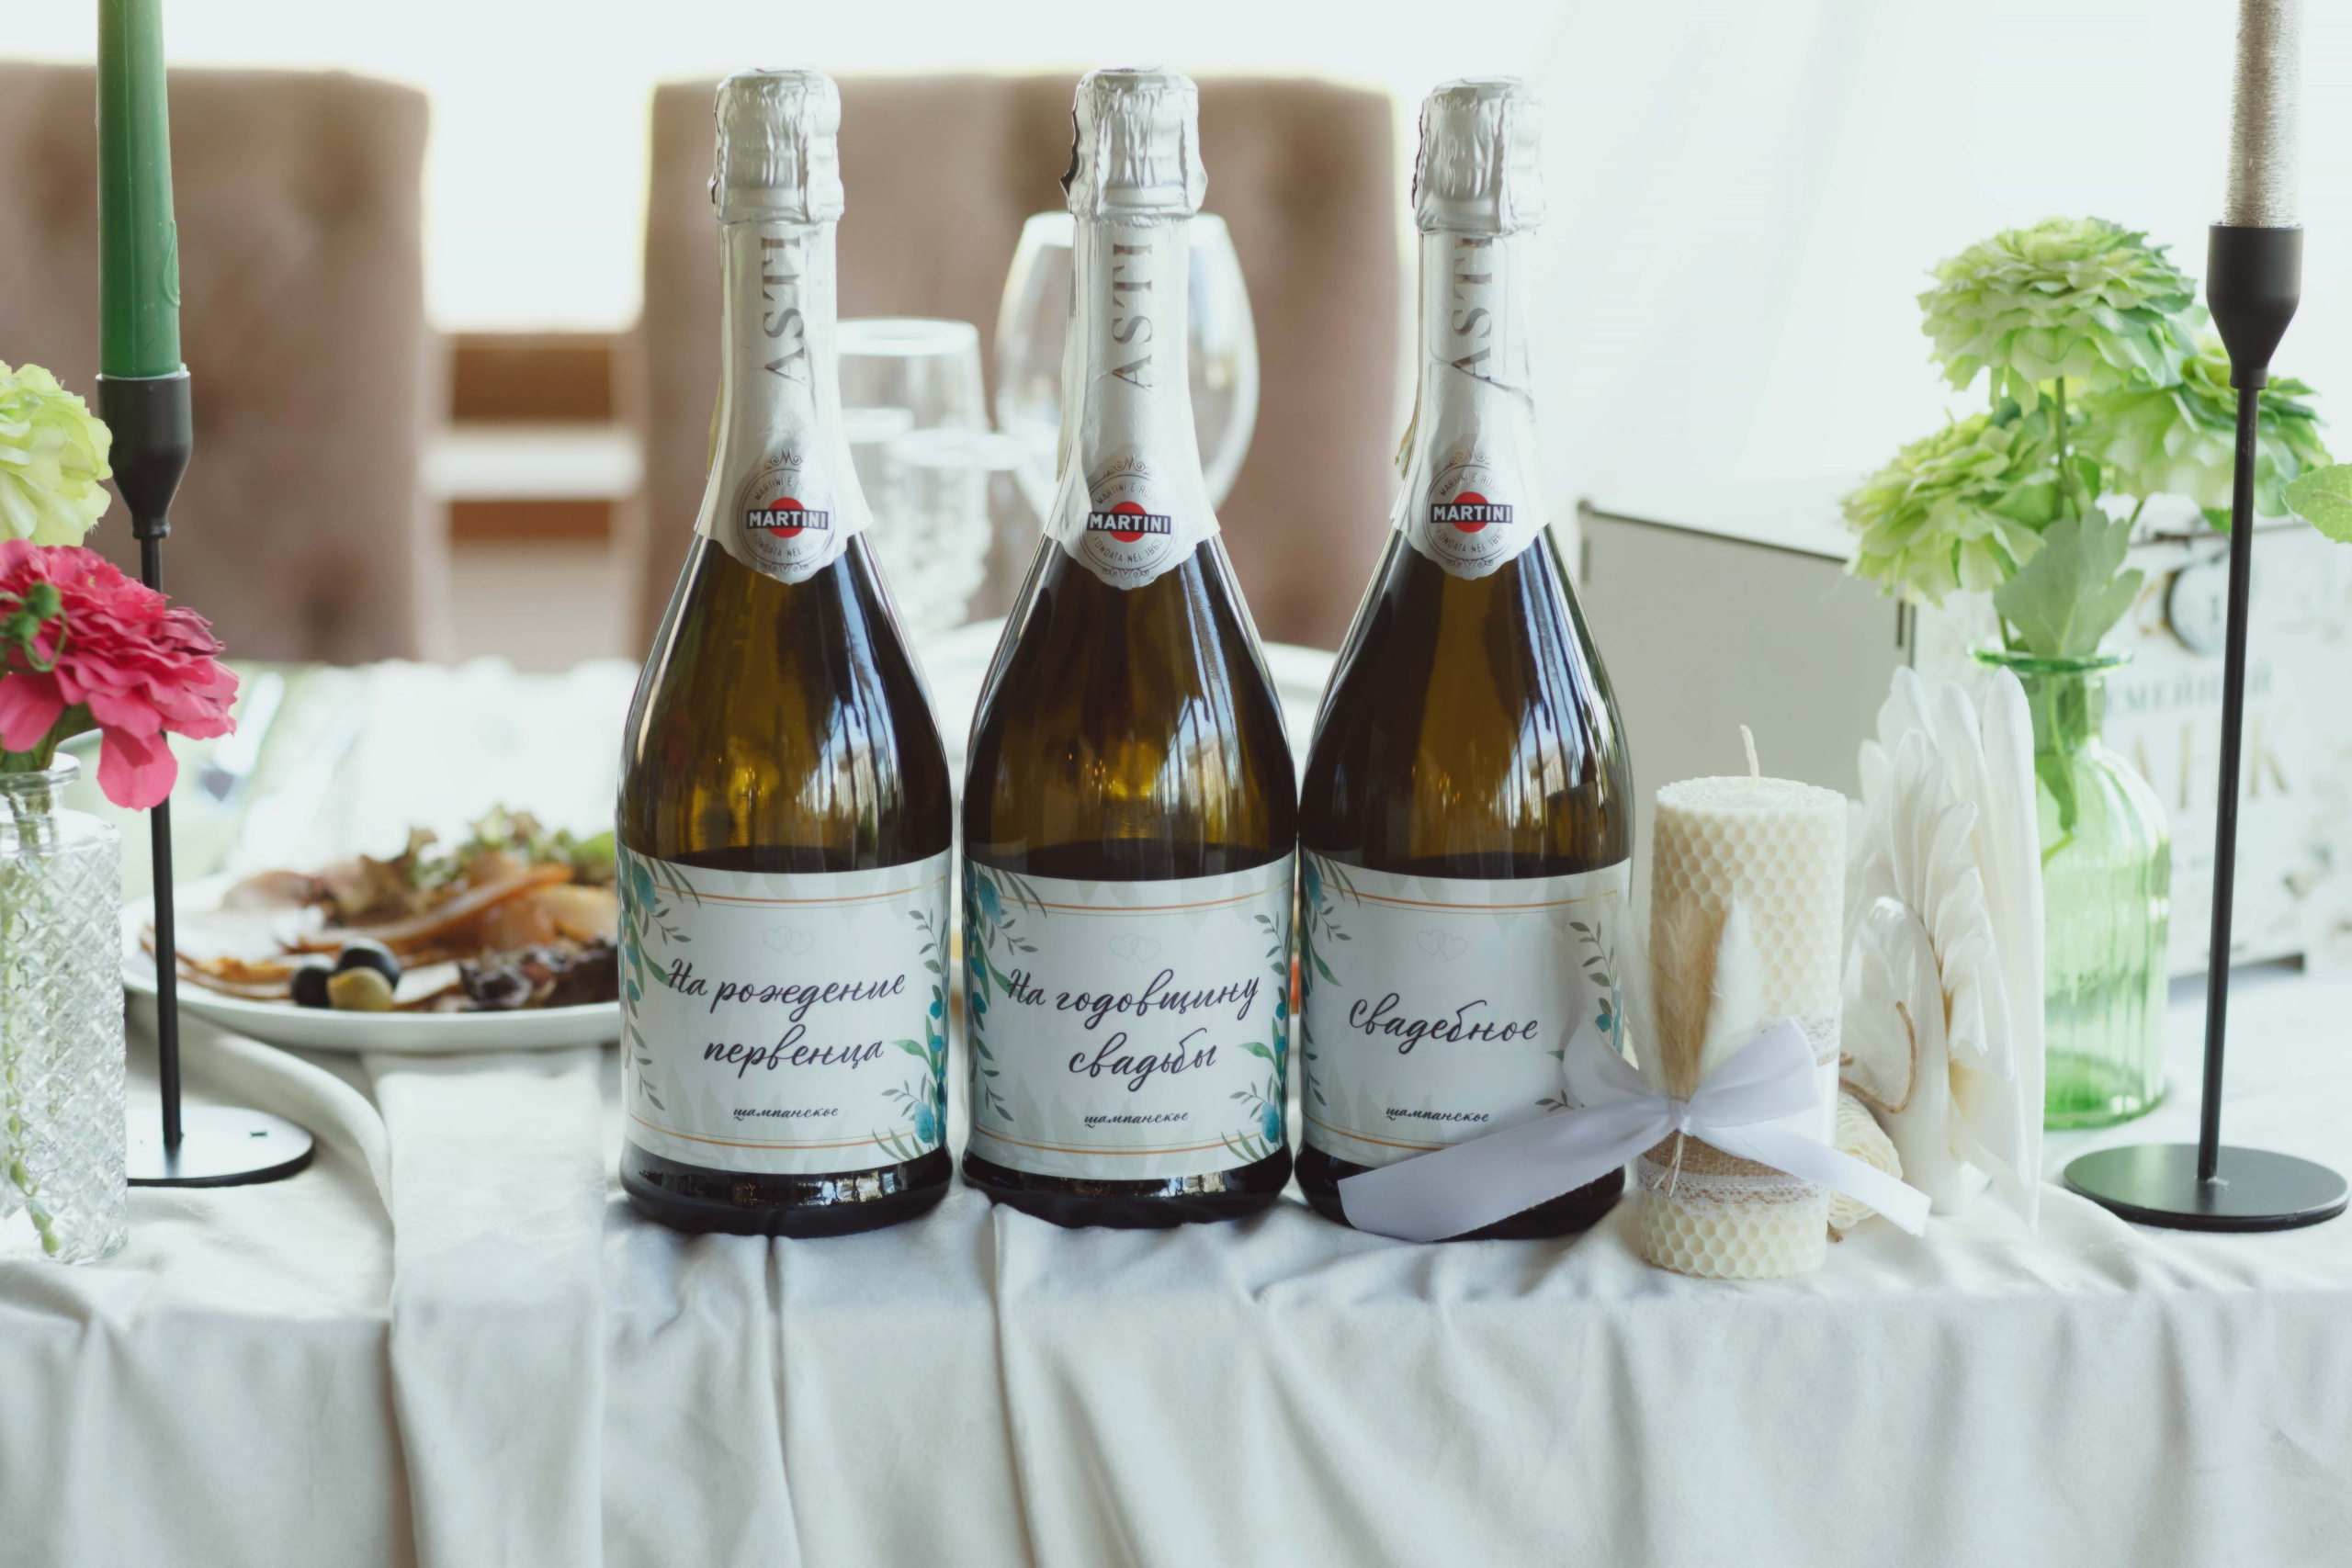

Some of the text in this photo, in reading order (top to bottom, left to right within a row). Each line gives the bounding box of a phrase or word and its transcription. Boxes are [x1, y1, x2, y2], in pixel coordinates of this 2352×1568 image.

[760, 235, 806, 386] ASTI
[1112, 243, 1153, 392] ASTI
[1451, 235, 1493, 382] ASTI
[1096, 482, 1126, 505] MARTINI
[749, 512, 825, 527] MARTINI
[1090, 514, 1168, 532] MARTINI
[1433, 505, 1510, 521] MARTINI
[1093, 536, 1122, 562] FONDATA
[1127, 552, 1144, 563] NEL
[668, 958, 906, 1022] На рождение
[1007, 969, 1260, 1031] На годовщину
[704, 1023, 885, 1079] первенца
[1069, 1028, 1217, 1092] свадьбы
[733, 1107, 839, 1122] шампанское
[1083, 1111, 1189, 1129] шампанское
[1385, 1107, 1490, 1123] шампанское
